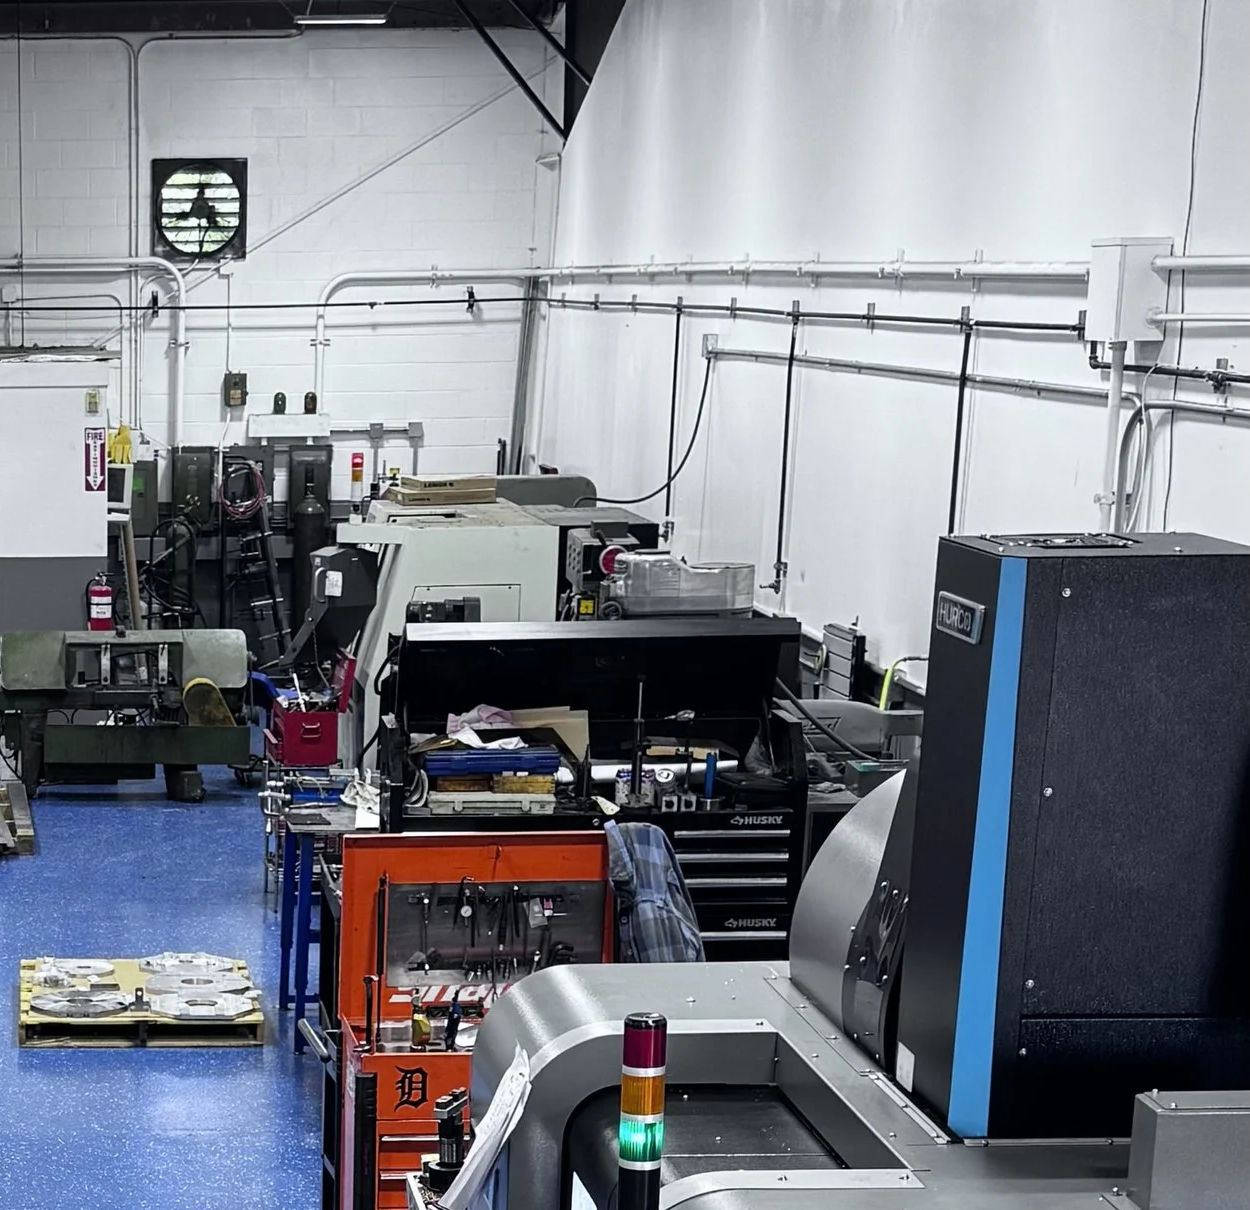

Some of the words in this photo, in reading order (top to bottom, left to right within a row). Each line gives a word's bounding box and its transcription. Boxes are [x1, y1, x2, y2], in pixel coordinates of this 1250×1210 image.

[87, 432, 103, 441] FIRE
[939, 602, 972, 632] HURCO
[744, 816, 783, 825] HUSKY
[738, 918, 777, 928] HUSKY
[394, 1065, 428, 1112] D
